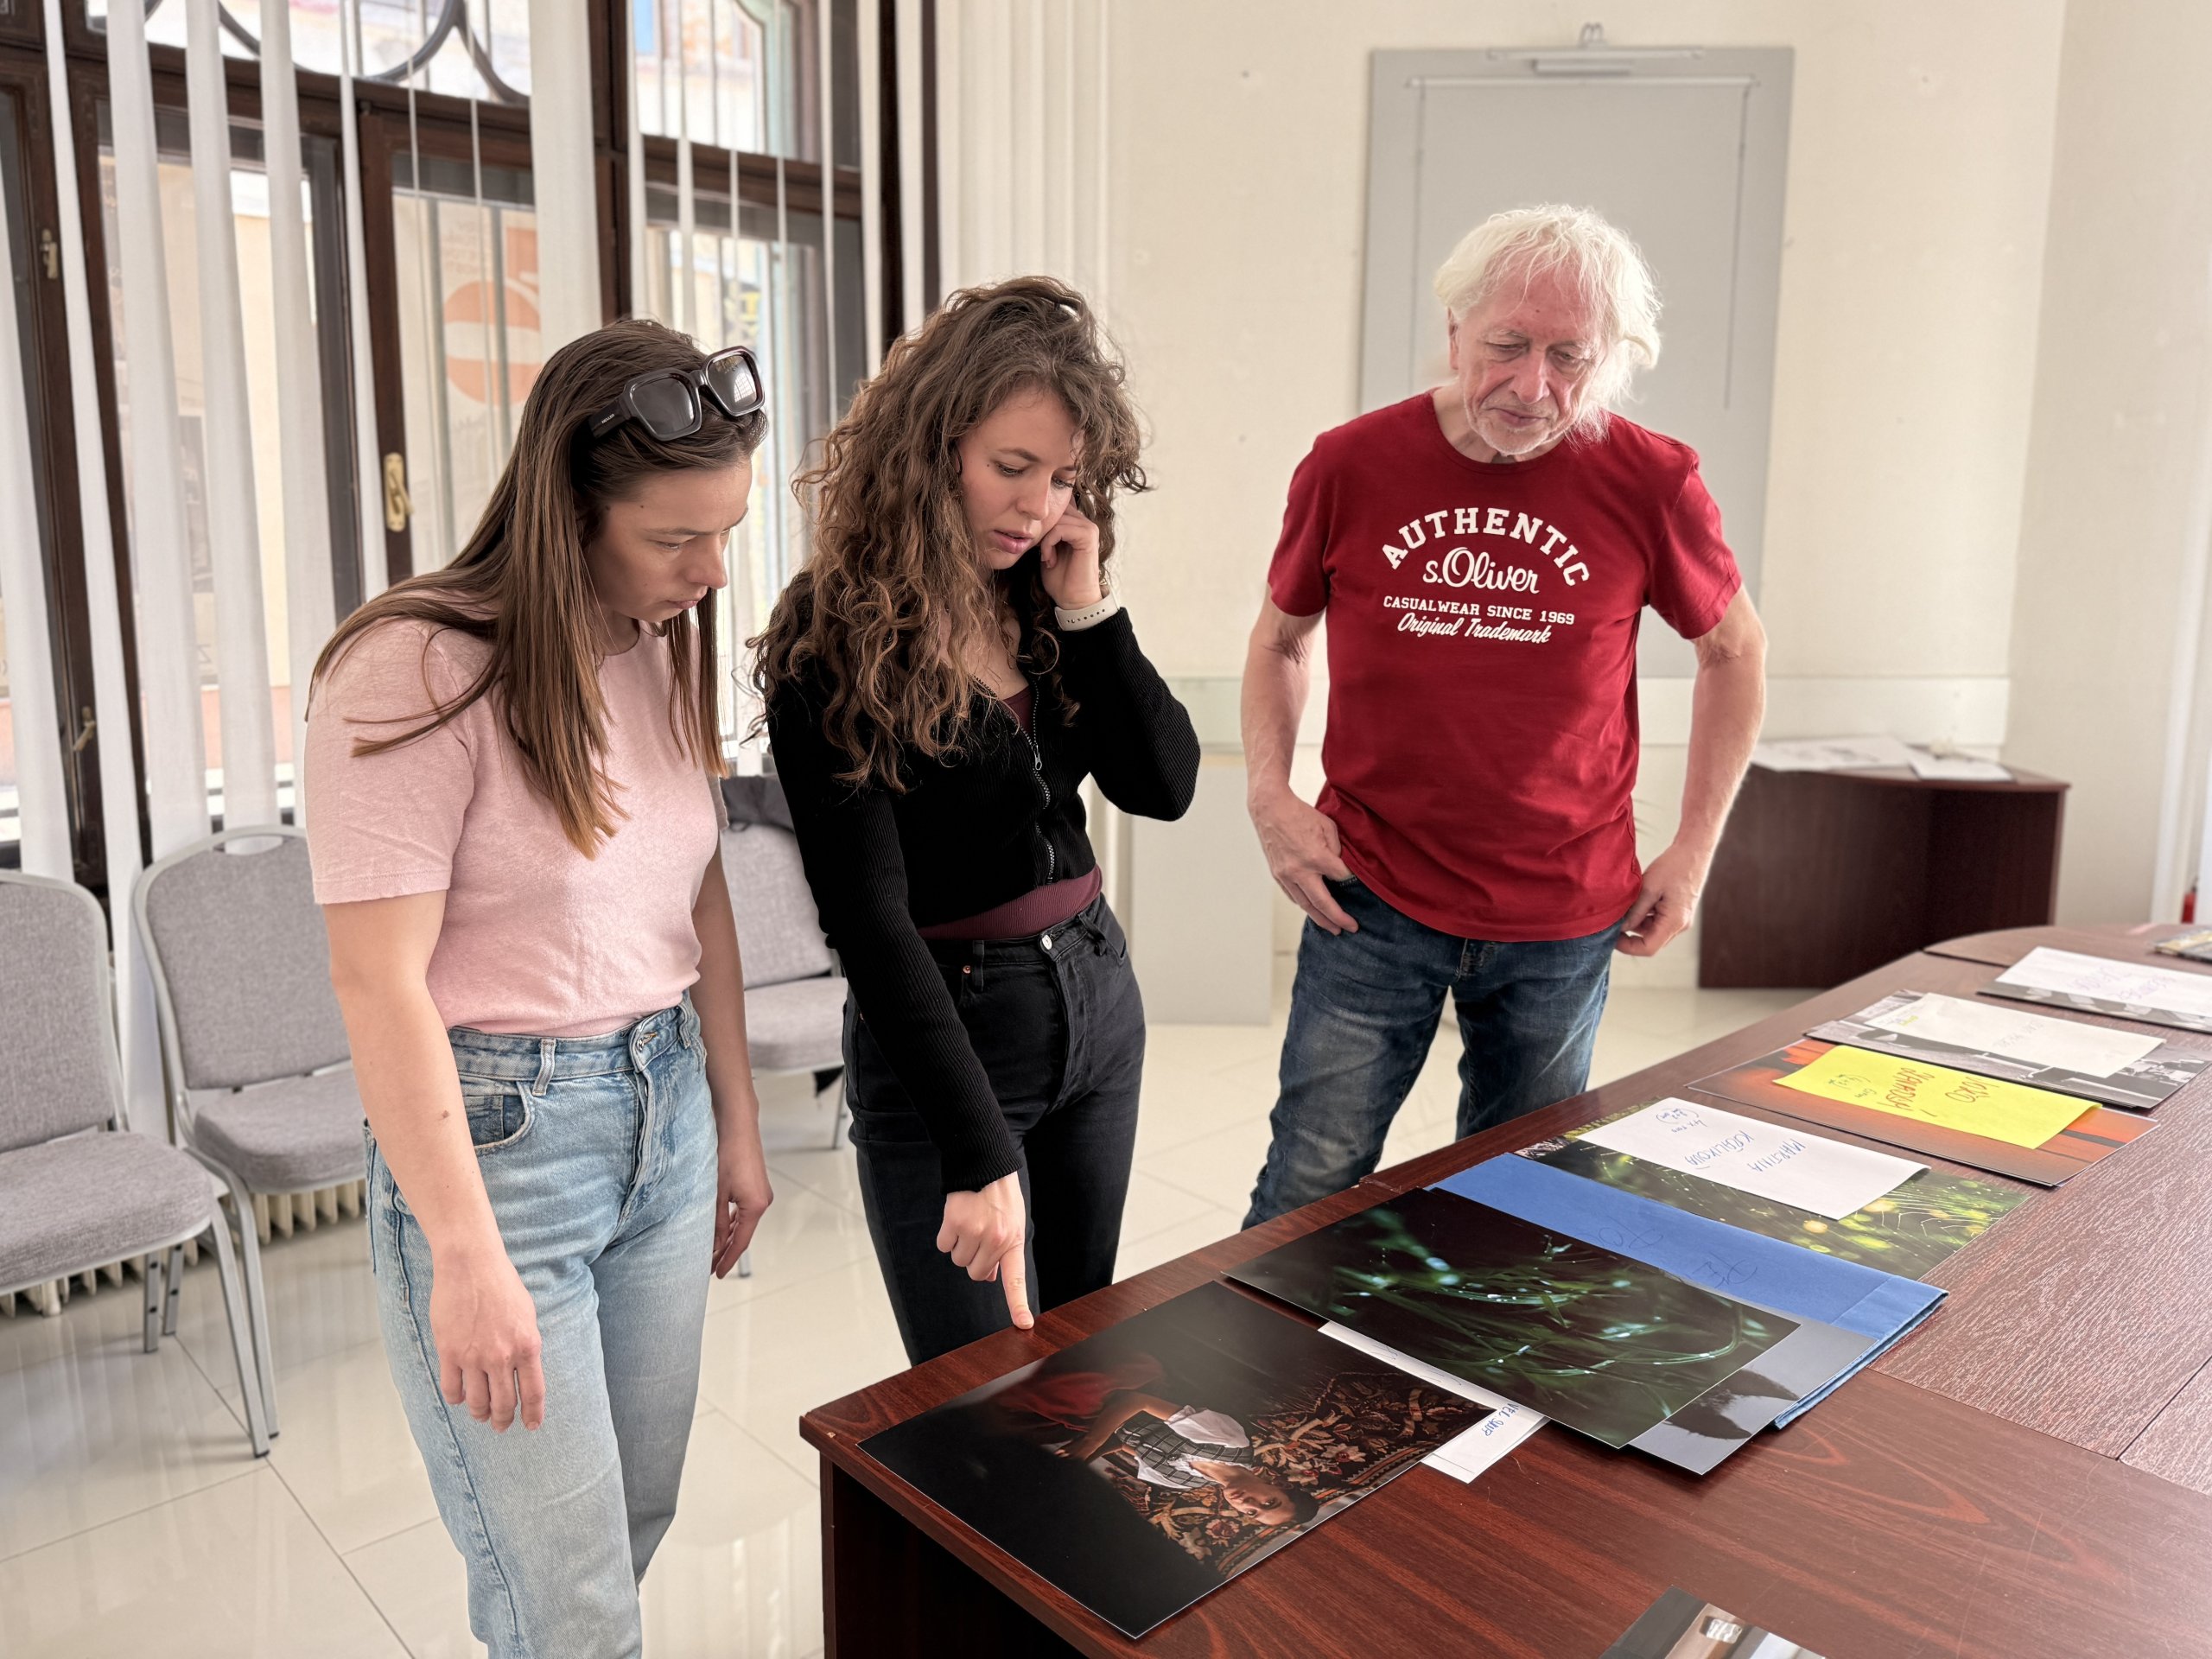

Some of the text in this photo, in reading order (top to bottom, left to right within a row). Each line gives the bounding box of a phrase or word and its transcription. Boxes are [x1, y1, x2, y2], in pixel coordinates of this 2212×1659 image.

[1382, 507, 1590, 587] AUTHENTIC
[1422, 546, 1540, 594] s.Oliver
[1383, 595, 1575, 626] CASUALWEAR SINCE 1969
[1397, 612, 1552, 645] Original Trademark
[1747, 1138, 1806, 1172] MARTINA
